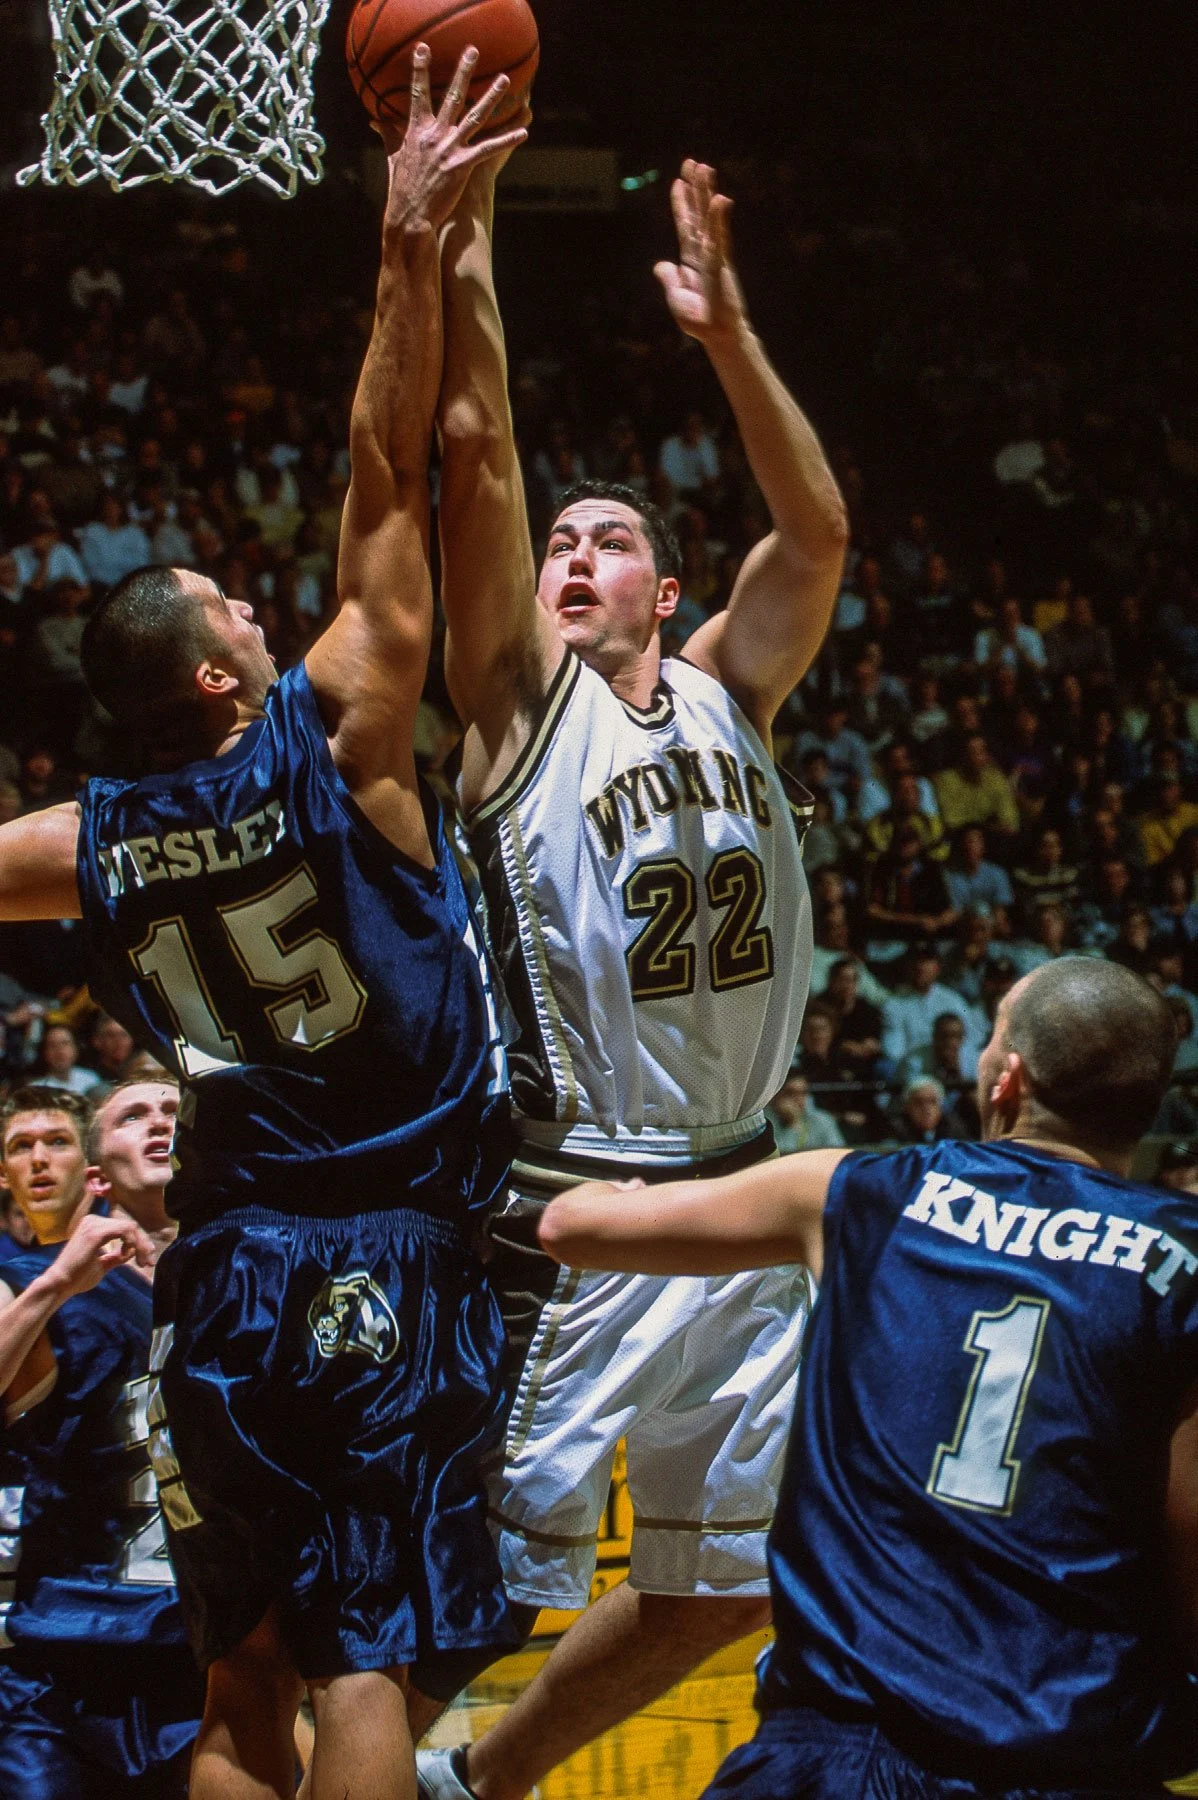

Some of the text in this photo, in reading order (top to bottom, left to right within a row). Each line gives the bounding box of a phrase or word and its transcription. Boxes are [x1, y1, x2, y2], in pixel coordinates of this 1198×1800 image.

[128, 860, 368, 1080] 15
[622, 845, 774, 1003] 22
[902, 1170, 1198, 1297] KNIGHT
[926, 1294, 1051, 1516] 1
